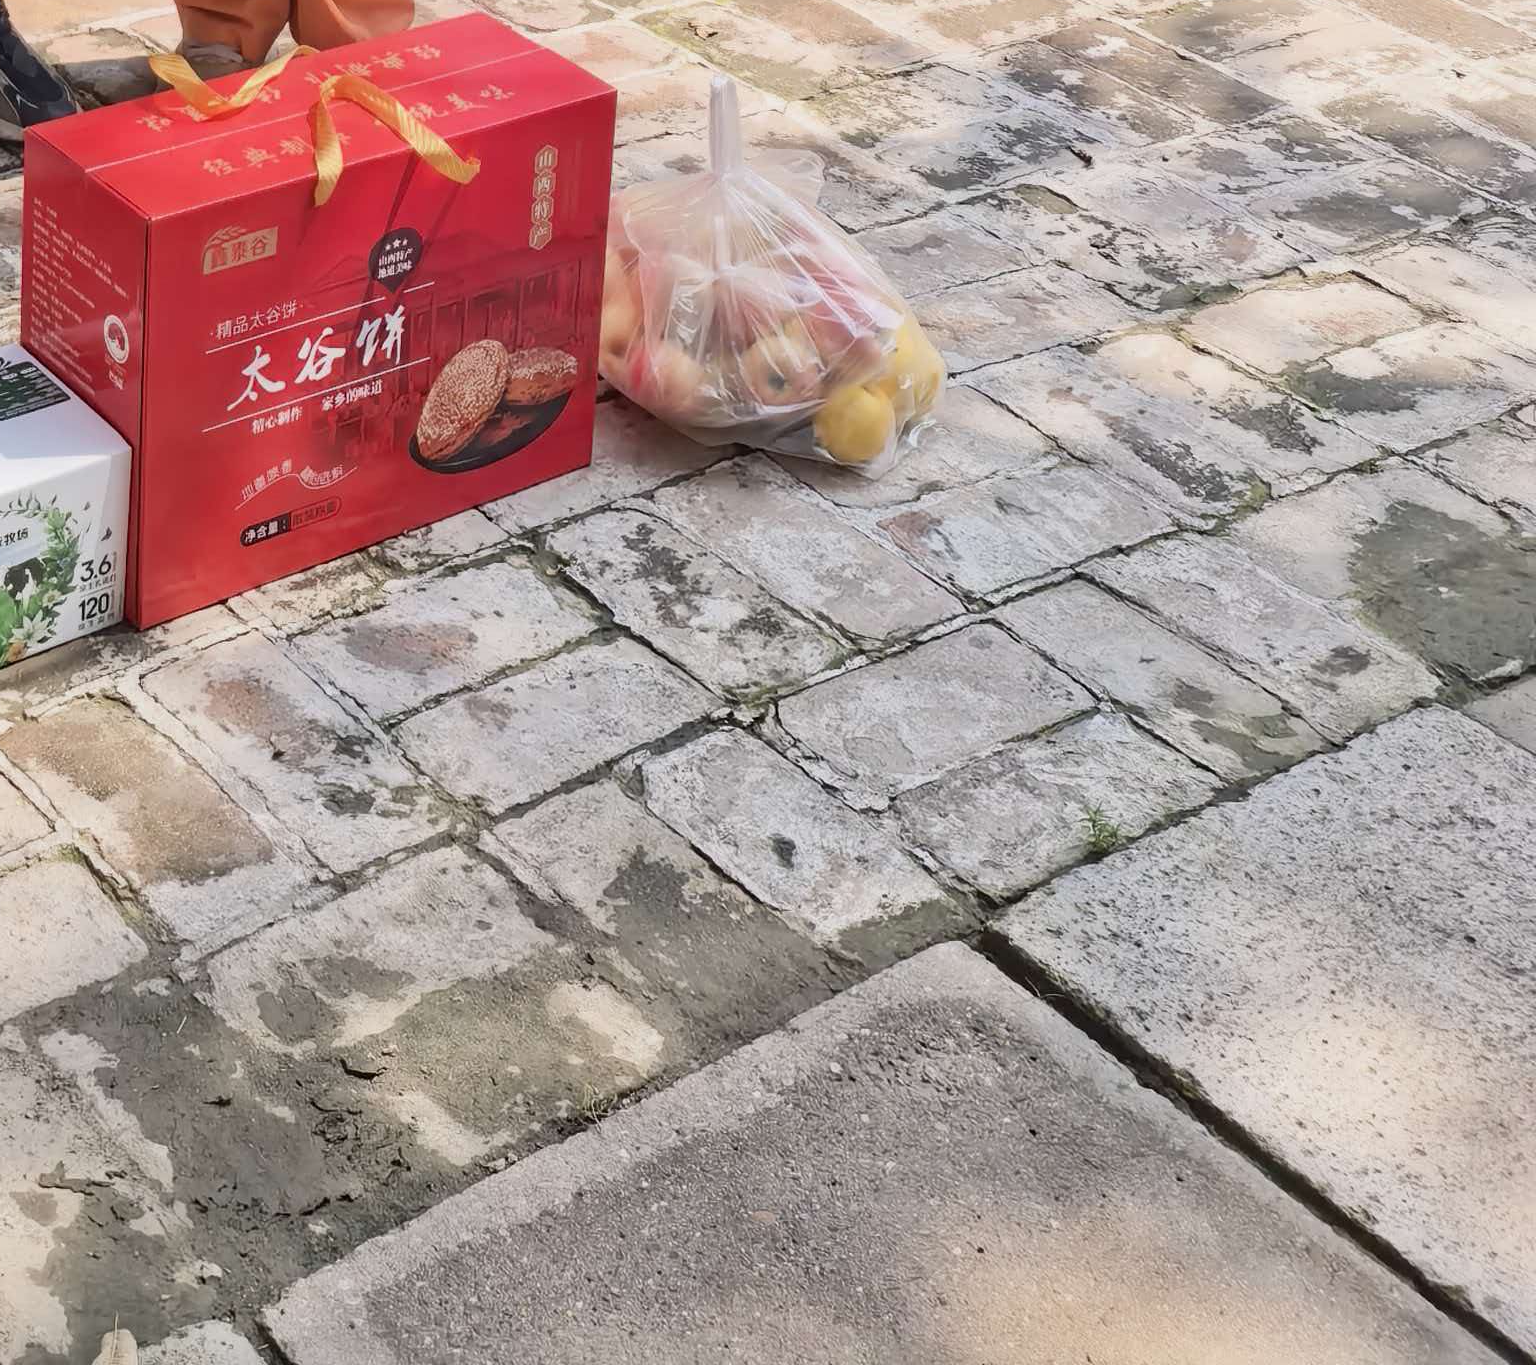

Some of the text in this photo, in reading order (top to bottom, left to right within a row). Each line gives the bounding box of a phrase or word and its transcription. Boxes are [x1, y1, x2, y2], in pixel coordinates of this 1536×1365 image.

[532, 149, 554, 247] 山西特产
[378, 247, 413, 267] 山西特产
[227, 305, 405, 411] 太谷饼
[252, 380, 383, 434] 精心制作 家乡的味道
[80, 555, 112, 582] 3.6
[78, 593, 110, 621] 120
